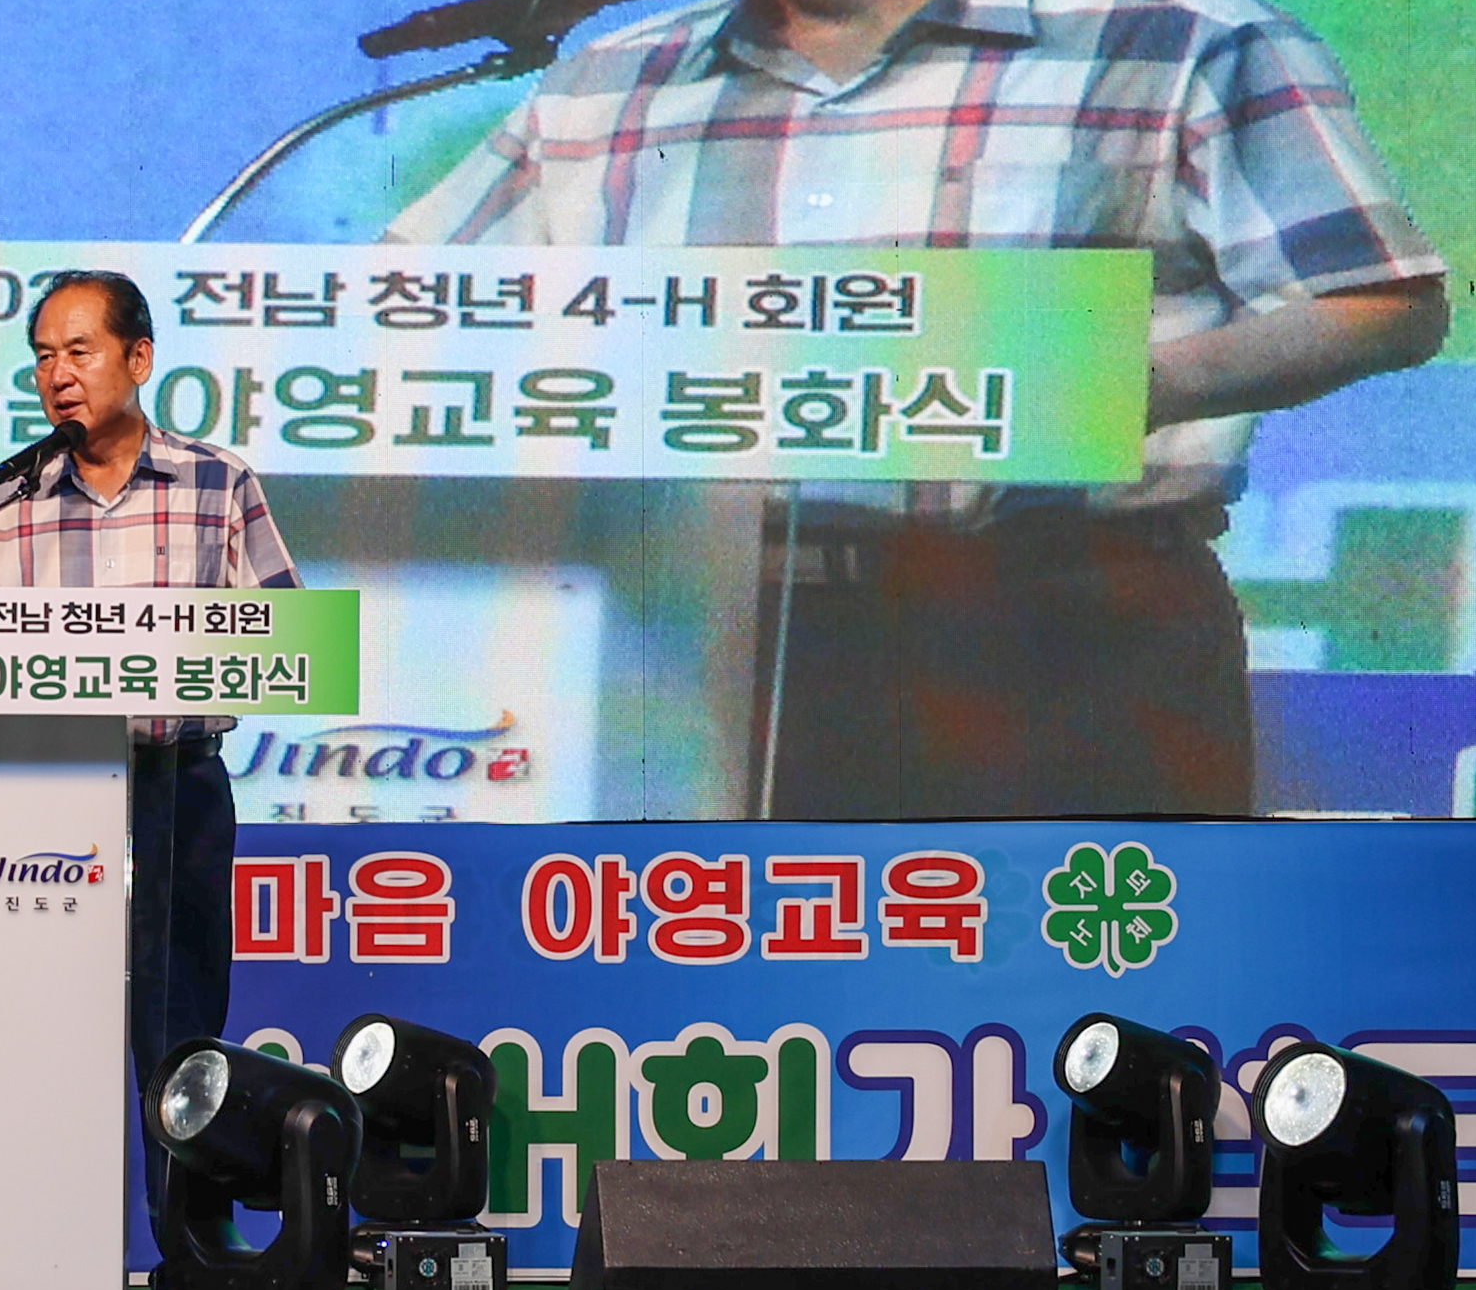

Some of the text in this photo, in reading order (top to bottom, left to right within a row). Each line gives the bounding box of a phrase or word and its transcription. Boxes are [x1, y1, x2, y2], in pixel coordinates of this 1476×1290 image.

[172, 270, 345, 329] 전남
[366, 271, 536, 331] 청년
[561, 274, 718, 329] 4-H
[742, 273, 917, 333] 회원
[154, 364, 618, 453] 야영교육
[659, 367, 1005, 455] 봉화식
[60, 601, 126, 635] 청년
[135, 603, 196, 634] 4-H
[204, 602, 272, 637] 회원
[174, 654, 309, 703] 봉화식
[232, 856, 451, 960] 마음
[526, 854, 984, 962] 야영교육
